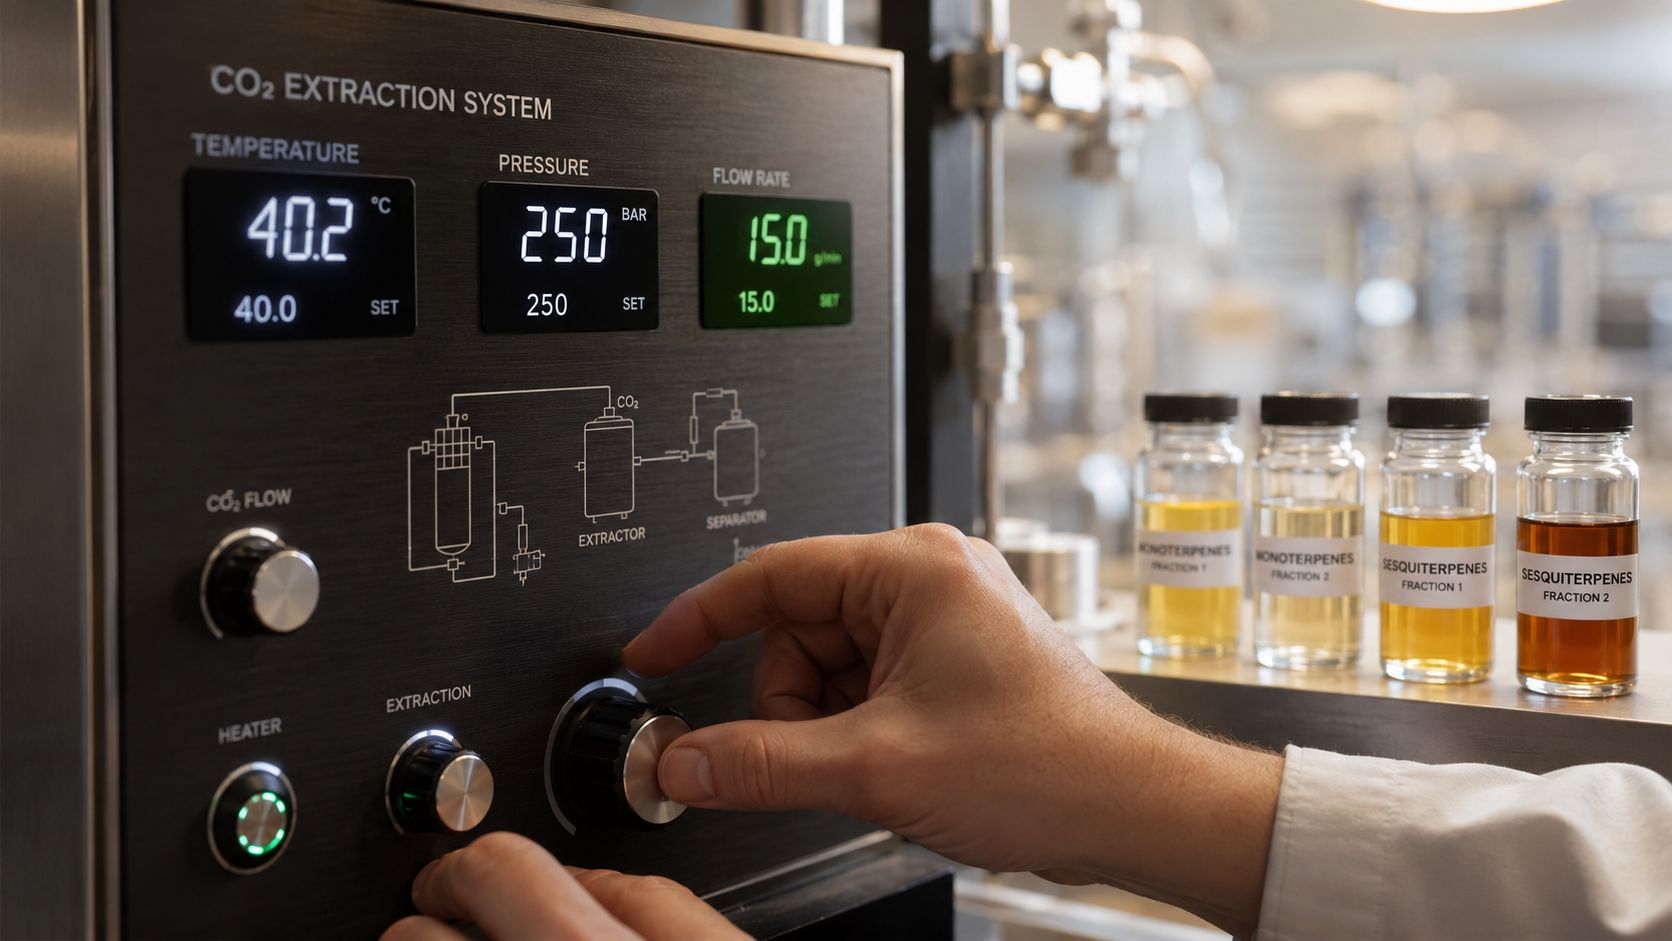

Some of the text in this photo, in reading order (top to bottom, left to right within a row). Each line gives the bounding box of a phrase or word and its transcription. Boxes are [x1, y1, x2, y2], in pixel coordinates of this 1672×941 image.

[284, 72, 456, 113] EXTRACTION
[463, 90, 553, 120] SYSTEM
[191, 132, 360, 164] TEMPERATURE
[498, 153, 589, 176] PRESSURE
[712, 167, 791, 188] FLOW RATE
[246, 194, 392, 262] 40.2 °C
[519, 204, 648, 263] 250 BAR
[748, 213, 808, 266] 15.0
[233, 294, 399, 324] 40.0 SET
[526, 292, 646, 317] 250 SET
[738, 290, 840, 314] 15.0 SET
[244, 488, 292, 510] FLOW
[706, 509, 767, 530] SEPARATOR
[578, 526, 646, 548] EXTRACTOR
[1151, 561, 1207, 573] FRACTION 1
[1255, 550, 1354, 566] MONOTERPENES
[1382, 558, 1488, 577] SESQUITERPENES
[1271, 569, 1331, 582] FRACTION 2
[1401, 580, 1463, 593] FRACTION 1
[1521, 567, 1633, 586] SESQUITERPENES
[1543, 590, 1610, 603] FRACTION 2
[386, 684, 472, 713] EXTRACTION
[217, 717, 282, 745] HEATER
